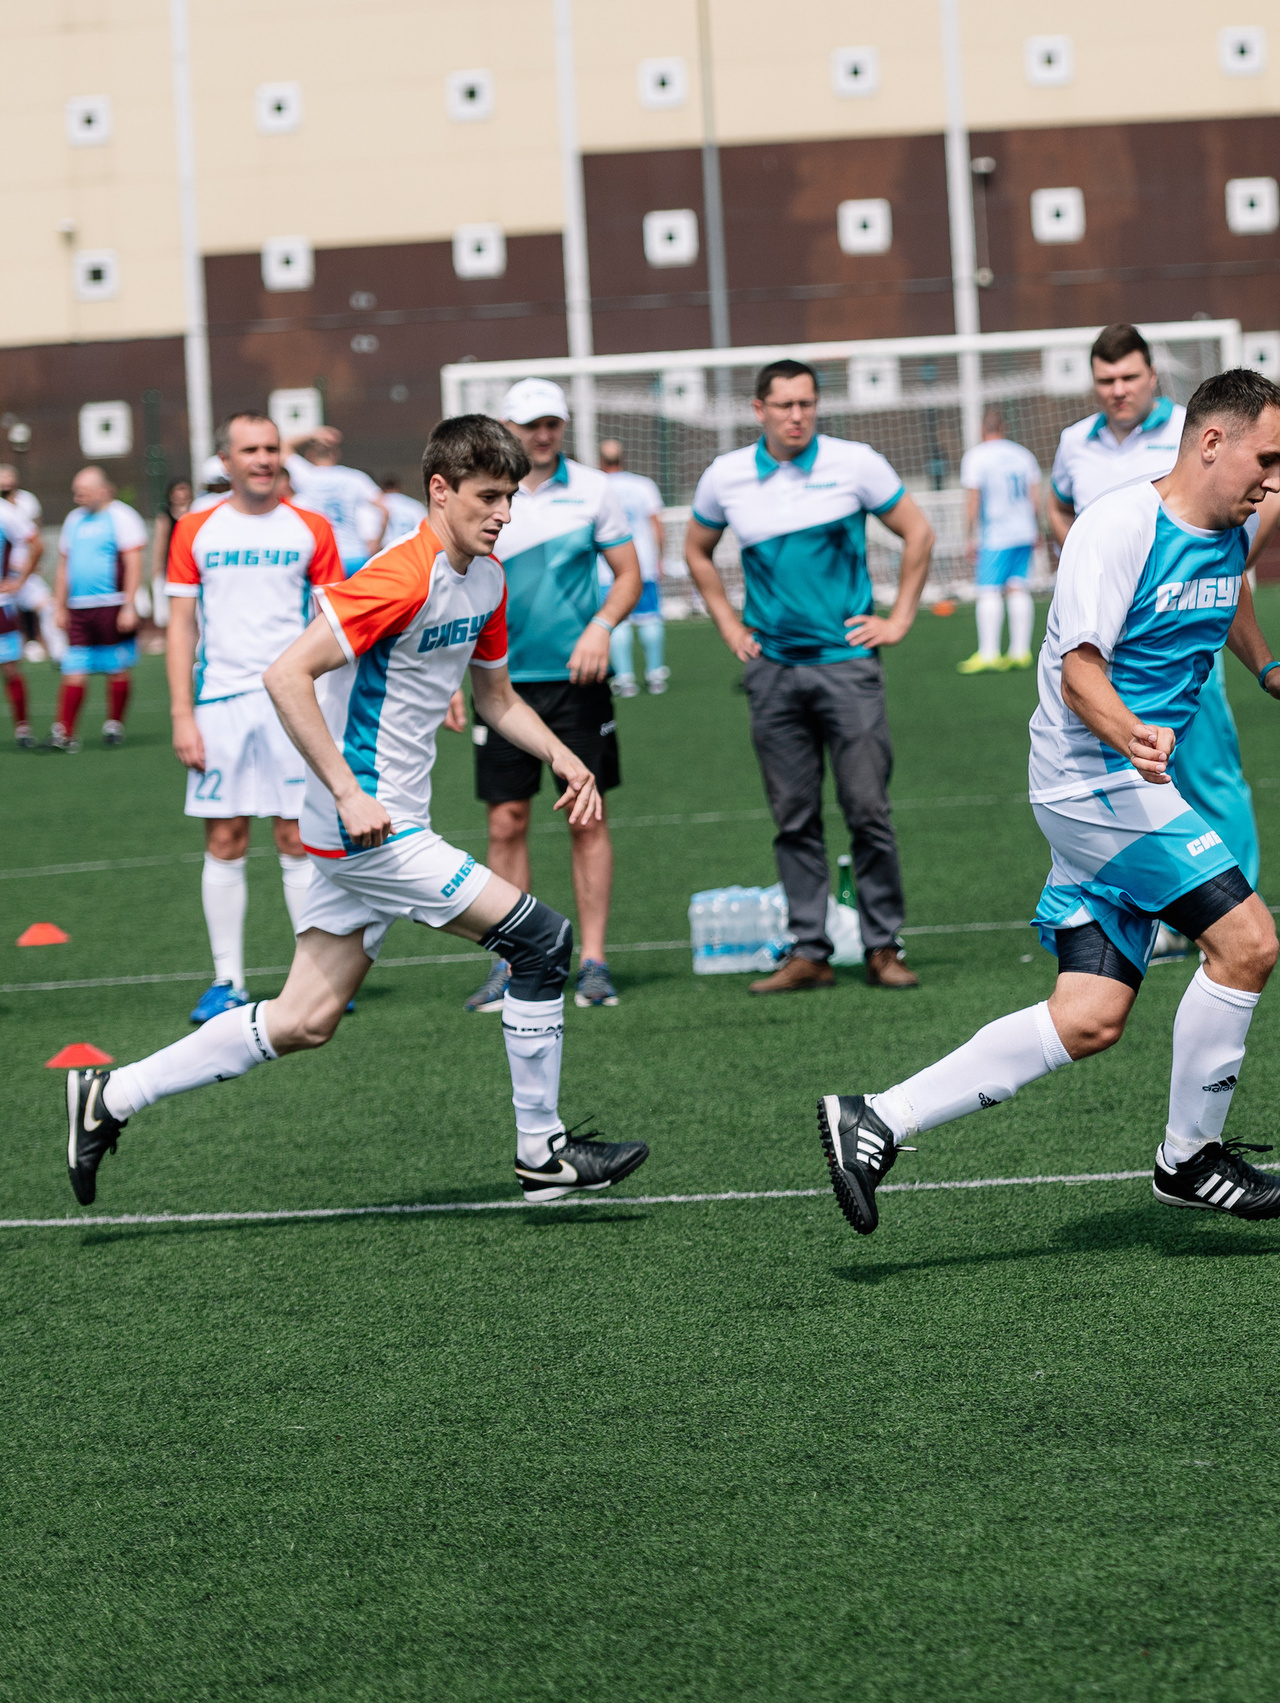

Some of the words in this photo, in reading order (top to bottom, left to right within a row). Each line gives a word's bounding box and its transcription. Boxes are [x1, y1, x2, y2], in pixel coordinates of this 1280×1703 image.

[205, 549, 299, 568] СИБУР
[195, 769, 222, 800] 22
[440, 853, 476, 898] СИБУ
